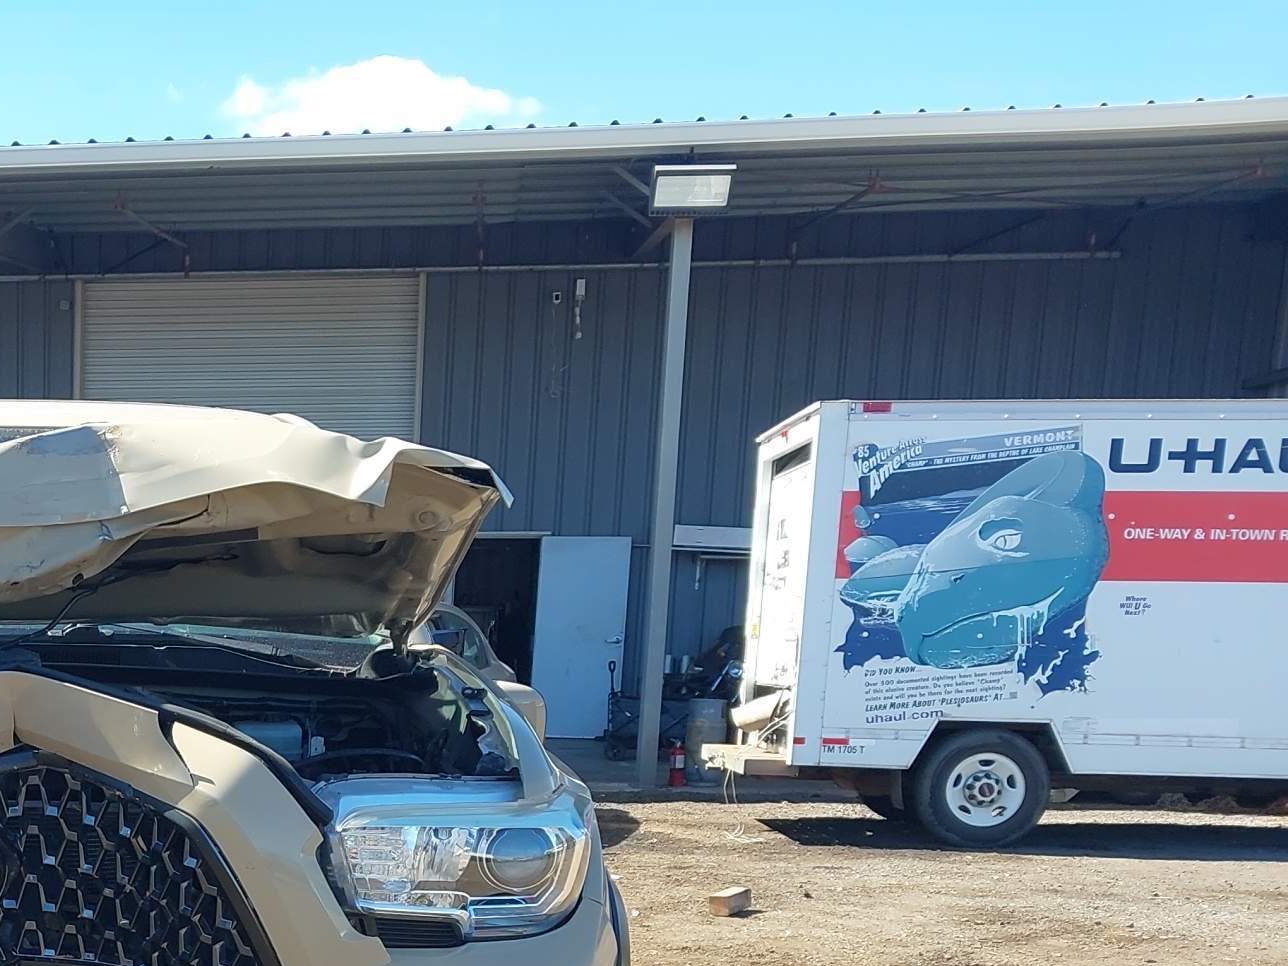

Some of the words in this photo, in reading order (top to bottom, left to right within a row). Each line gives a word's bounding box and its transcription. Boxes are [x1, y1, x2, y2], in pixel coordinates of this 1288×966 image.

[1004, 430, 1074, 447] VERMONT
[854, 447, 897, 475] Venture
[944, 455, 969, 463] MYSTERY
[970, 453, 986, 461] FROM
[988, 451, 998, 459] THE
[999, 449, 1020, 458] DEPTHS
[1021, 448, 1029, 456] OF
[1029, 446, 1044, 454] LAKE
[1109, 438, 1288, 473] U-HA
[870, 445, 922, 499] America
[1124, 527, 1191, 540] ONE-WAY
[1194, 528, 1205, 540] &
[1210, 528, 1275, 541] IN-TOWN
[1134, 602, 1141, 610] U
[865, 703, 887, 712] LEARN
[889, 701, 909, 709] MORE
[912, 699, 936, 707] ABOUT
[823, 745, 834, 753] TM
[838, 745, 857, 754] 1705
[859, 745, 865, 754] T
